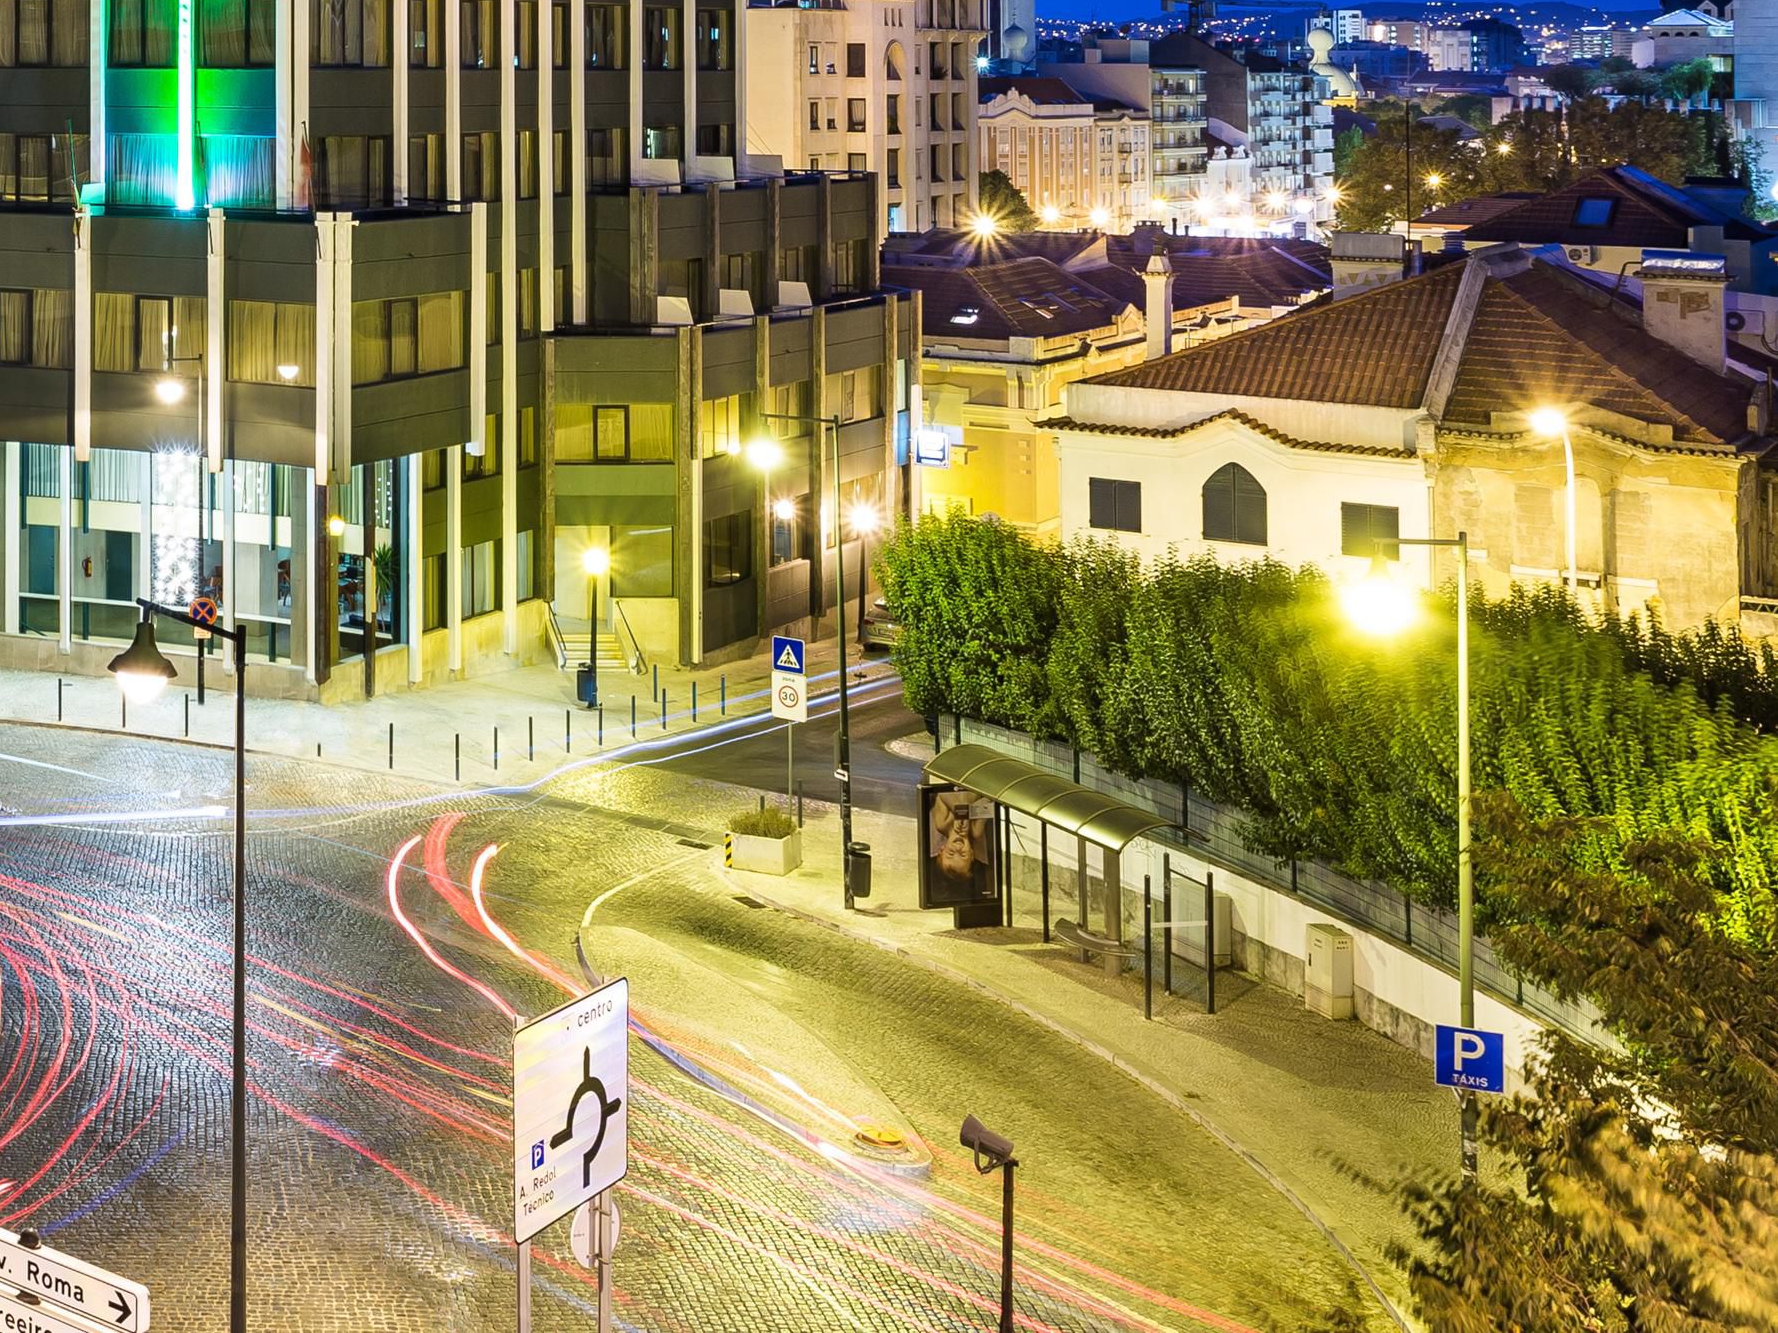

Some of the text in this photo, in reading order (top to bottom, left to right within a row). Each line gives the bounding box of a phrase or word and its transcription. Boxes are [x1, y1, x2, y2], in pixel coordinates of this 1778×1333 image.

[782, 691, 796, 702] 30
[577, 999, 613, 1028] centro
[1454, 1031, 1485, 1071] P
[1452, 1074, 1489, 1087] TÁXIS
[533, 1166, 557, 1191] Redol
[523, 1189, 555, 1216] Técnico
[27, 1261, 85, 1303] Roma
